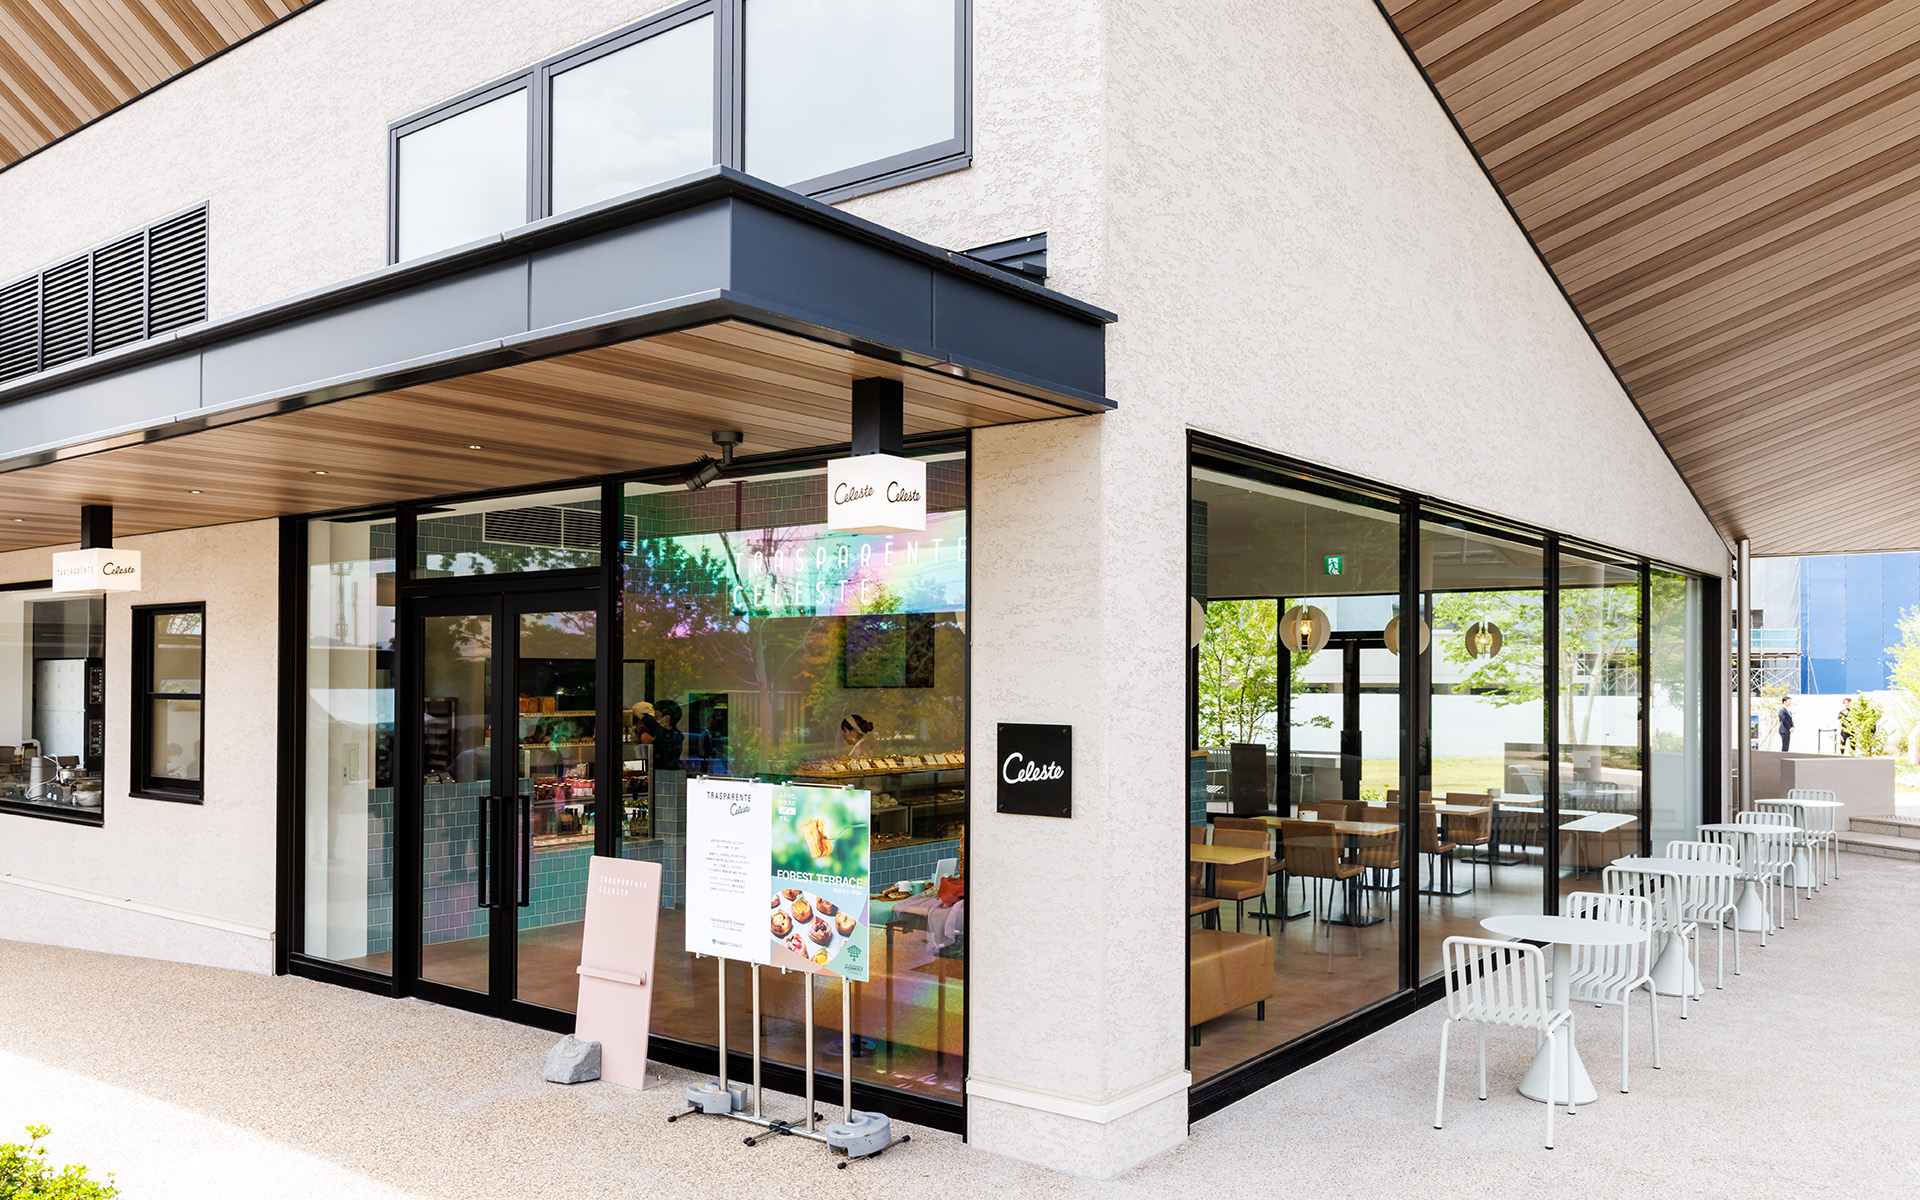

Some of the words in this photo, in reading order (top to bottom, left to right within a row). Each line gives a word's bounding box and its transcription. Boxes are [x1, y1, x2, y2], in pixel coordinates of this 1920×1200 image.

[834, 482, 874, 505] Celeste
[886, 481, 921, 503] Celeste
[102, 562, 136, 576] Celeste
[733, 579, 870, 608] CELESTE
[1003, 752, 1064, 784] Celeste
[707, 791, 751, 802] TRASPARENTE
[730, 802, 750, 816] Celeste
[777, 869, 814, 883] FOREST
[816, 873, 863, 889] TERRACE
[599, 885, 628, 896] CELESTE
